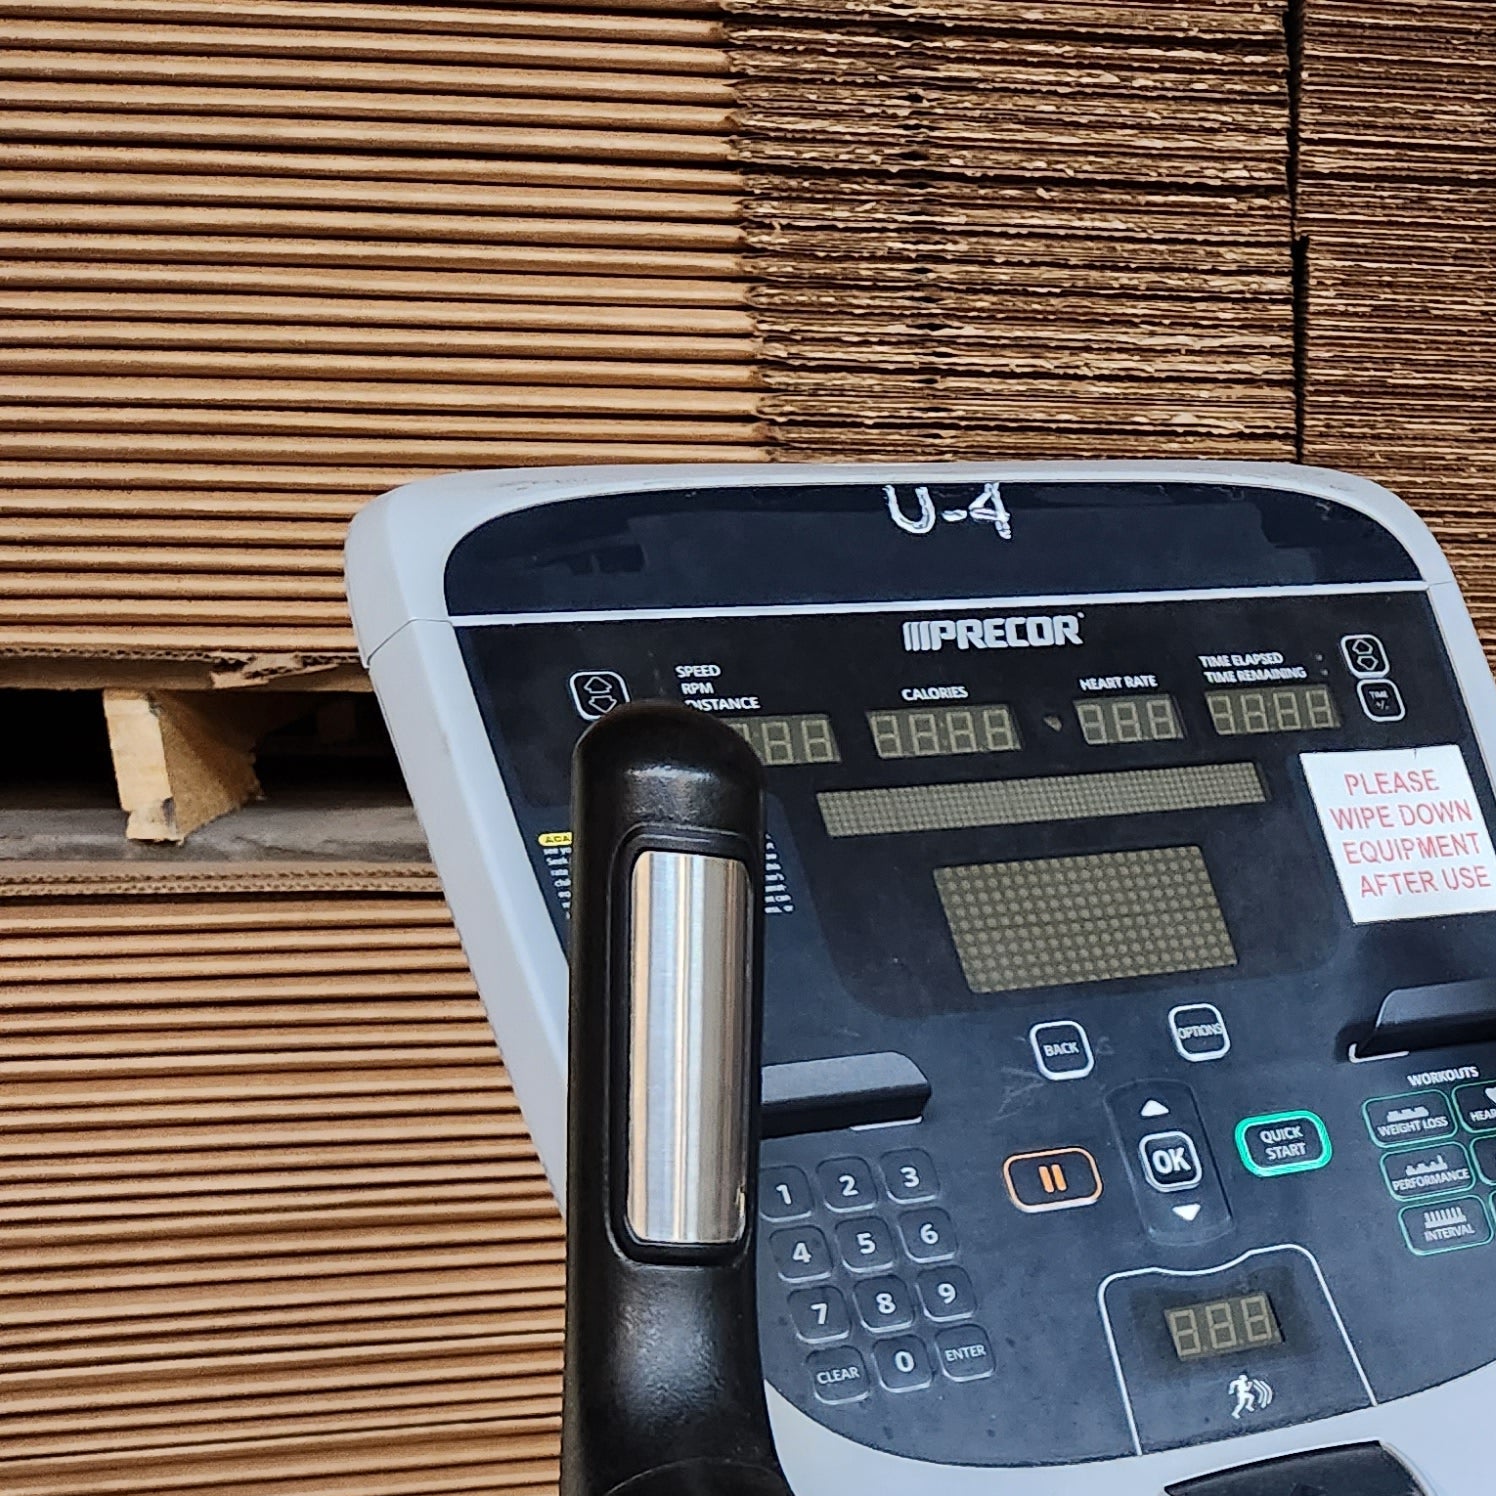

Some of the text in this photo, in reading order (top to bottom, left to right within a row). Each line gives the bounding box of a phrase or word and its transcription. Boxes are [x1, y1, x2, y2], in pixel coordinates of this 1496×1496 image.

[882, 482, 1012, 540] U-4
[926, 614, 1084, 651] PRECOR
[1198, 652, 1284, 668] TIME ELAPSED
[675, 664, 721, 678] SPEED
[1203, 666, 1307, 684] TIME REMAINING
[680, 682, 715, 695] RPM
[1079, 674, 1158, 691] HEART RATE
[901, 685, 969, 701] CALORIES
[1344, 769, 1440, 796] PLEASE
[1329, 799, 1473, 831] WIPE DOWN
[1342, 832, 1480, 865] EQUIPMENT
[1361, 865, 1491, 898] AFTER USE
[1177, 1022, 1223, 1040] OPTIONS
[1043, 1041, 1080, 1056] BACK
[1407, 1066, 1479, 1087] WORKOUTS
[1260, 1125, 1304, 1142] QUICK
[1377, 1116, 1449, 1137] WEIGHT LOSS
[1264, 1142, 1307, 1160] START
[1151, 1147, 1192, 1176] OK
[839, 1176, 858, 1196] 2
[901, 1167, 919, 1187] 3
[1392, 1167, 1471, 1191] PERFORMANCE
[777, 1185, 791, 1204] 1
[920, 1224, 938, 1244] 6
[1423, 1223, 1476, 1242] INTERVAL
[792, 1243, 811, 1263] 4
[857, 1233, 875, 1254] 5
[876, 1293, 895, 1314] 8
[938, 1284, 956, 1303] 9
[811, 1303, 827, 1324] 7
[895, 1352, 914, 1373] 0
[944, 1344, 986, 1362] ENTER
[816, 1367, 860, 1385] CLEAR
